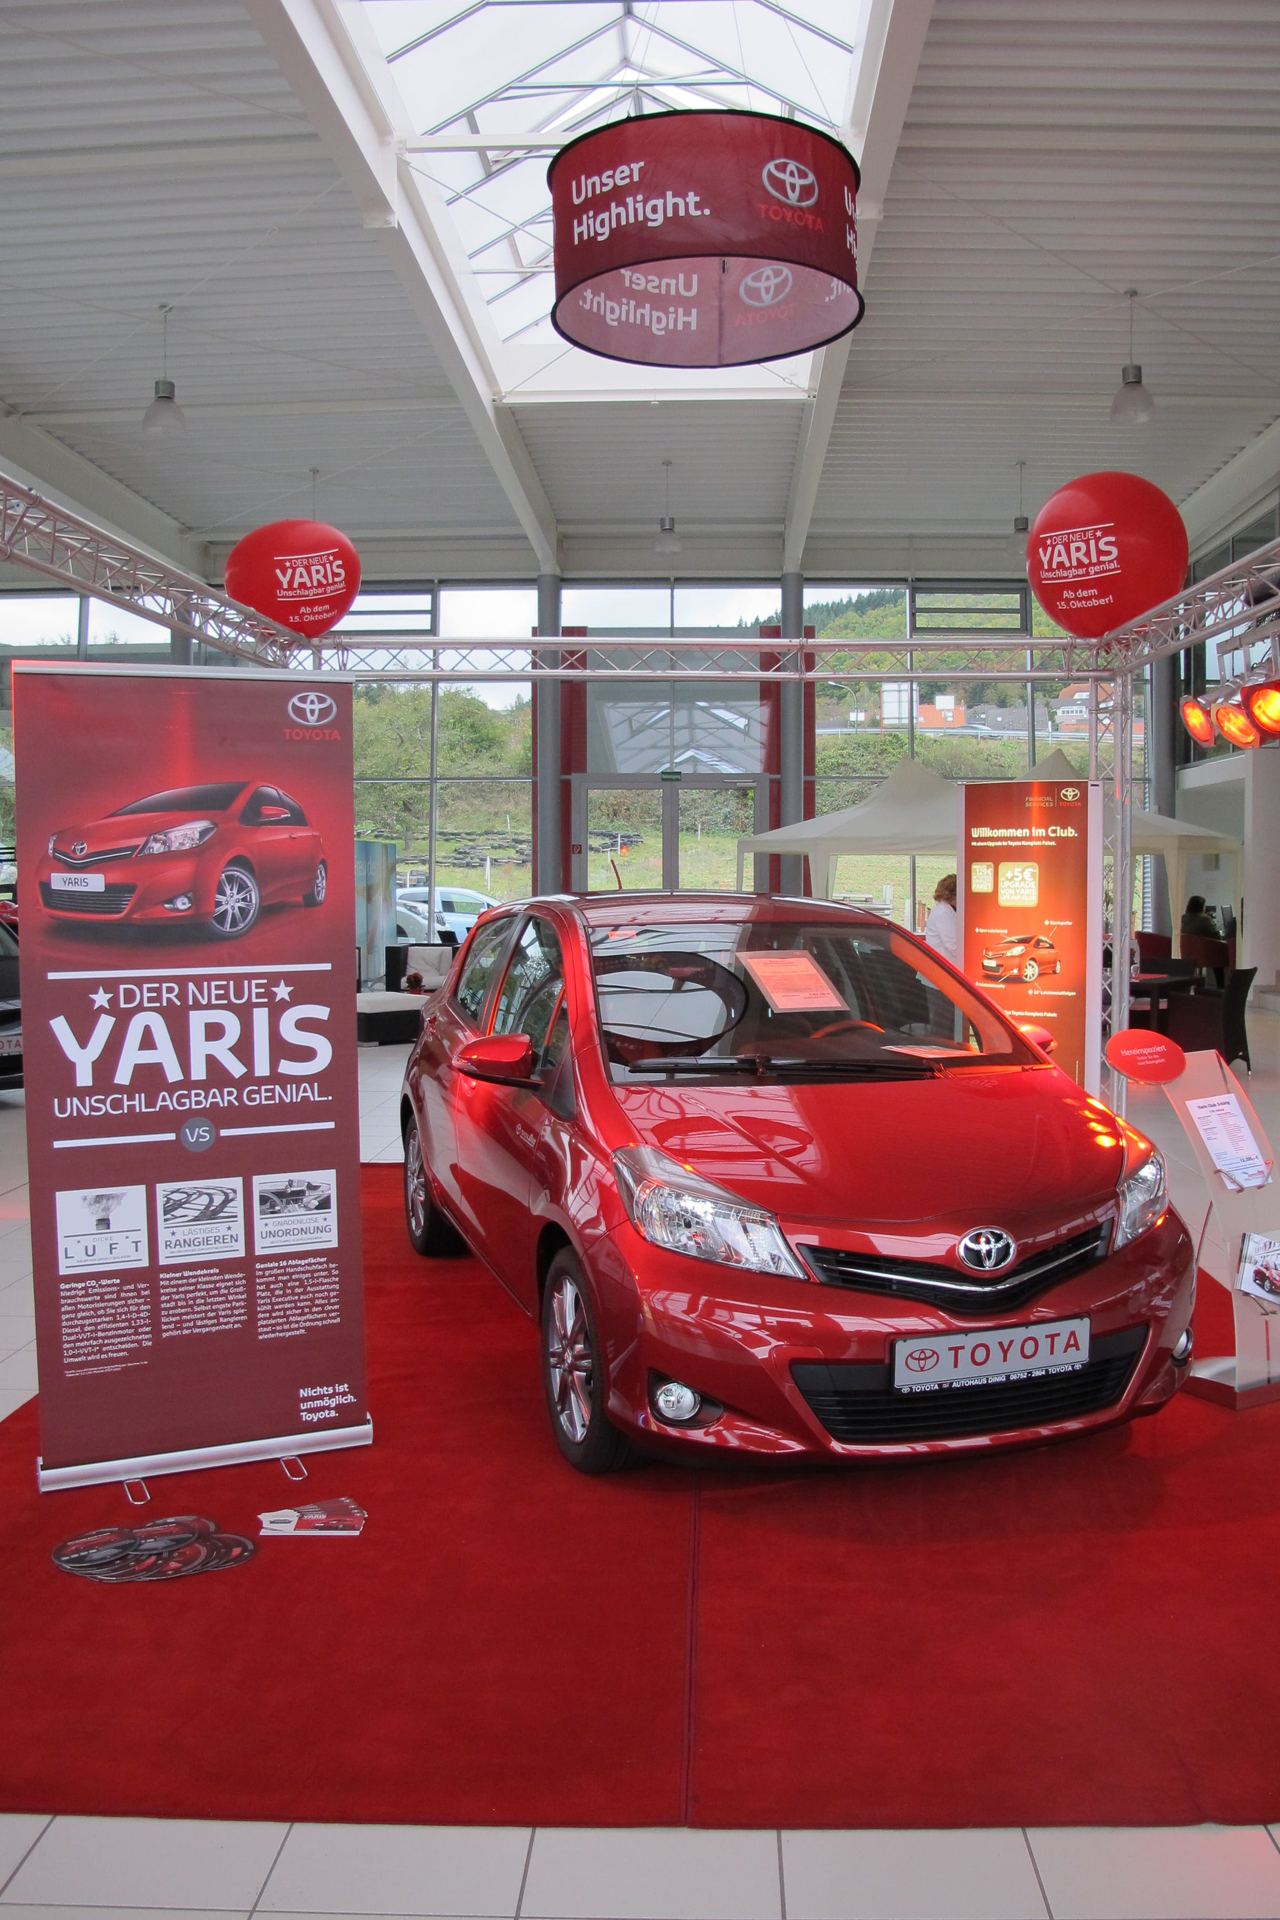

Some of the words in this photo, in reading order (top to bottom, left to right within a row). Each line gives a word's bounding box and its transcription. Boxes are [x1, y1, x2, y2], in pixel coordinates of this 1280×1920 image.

[572, 161, 644, 205] Unser
[573, 191, 711, 245] Highlight.
[757, 204, 824, 233] TOYOTA
[1052, 535, 1068, 545] DER
[1070, 530, 1094, 542] NEUE
[1039, 536, 1118, 569] YARIS
[292, 559, 308, 567] DER
[310, 555, 329, 565] NEUE
[275, 560, 345, 589] YARIS
[1040, 568, 1086, 579] Unschlagbar
[1089, 560, 1120, 575] genial.
[277, 587, 324, 597] Unschlagbar
[326, 581, 346, 593] genial.
[1063, 590, 1075, 599] Ab
[1077, 588, 1097, 597] dem
[300, 606, 311, 614] Ab
[313, 604, 329, 612] dem
[1057, 601, 1069, 609] 15.
[1070, 595, 1113, 609] Oktober!
[304, 610, 337, 622] Oktober!
[284, 729, 341, 741] TOYOTA
[971, 827, 1029, 838] Willkommen
[1032, 827, 1045, 837] im
[1048, 826, 1078, 837] Club.
[62, 877, 89, 888] YARIS
[119, 982, 181, 1009] DER
[188, 979, 268, 1006] NEUE
[49, 1004, 333, 1088] YARIS
[1120, 1044, 1167, 1056] Hereinspaziert
[54, 1087, 239, 1118] UNSCHLAGBAR
[243, 1082, 333, 1107] GENIAL.
[185, 1126, 211, 1143] VS
[273, 1217, 319, 1227] GNADENLOSE
[183, 1226, 220, 1236] LÄSTIGES
[261, 1225, 332, 1239] UNORDNUNG
[165, 1233, 238, 1250] RANGIEREN
[256, 1261, 279, 1269] Geniale
[288, 1257, 327, 1266] Ablagefächer
[160, 1271, 182, 1279] Kleiner
[183, 1268, 219, 1277] Wendekreis
[170, 1278, 187, 1286] einem
[216, 1281, 234, 1289] eignet
[60, 1289, 86, 1297] Niedrige
[89, 1286, 120, 1294] Emissions-
[194, 1304, 211, 1312] Selbst
[212, 1302, 231, 1311] engste
[948, 1330, 1080, 1369] TOYOTA
[64, 1355, 86, 1363] Umwelt
[912, 1384, 939, 1392] TOYOTA
[952, 1377, 987, 1388] AUTOHAUS
[988, 1375, 1006, 1384] DINIG
[1048, 1365, 1073, 1375] TOYOTA
[300, 1386, 333, 1398] Nichts
[335, 1383, 349, 1392] ist
[300, 1393, 357, 1410] unmöglich.
[300, 1409, 339, 1422] Toyota.
